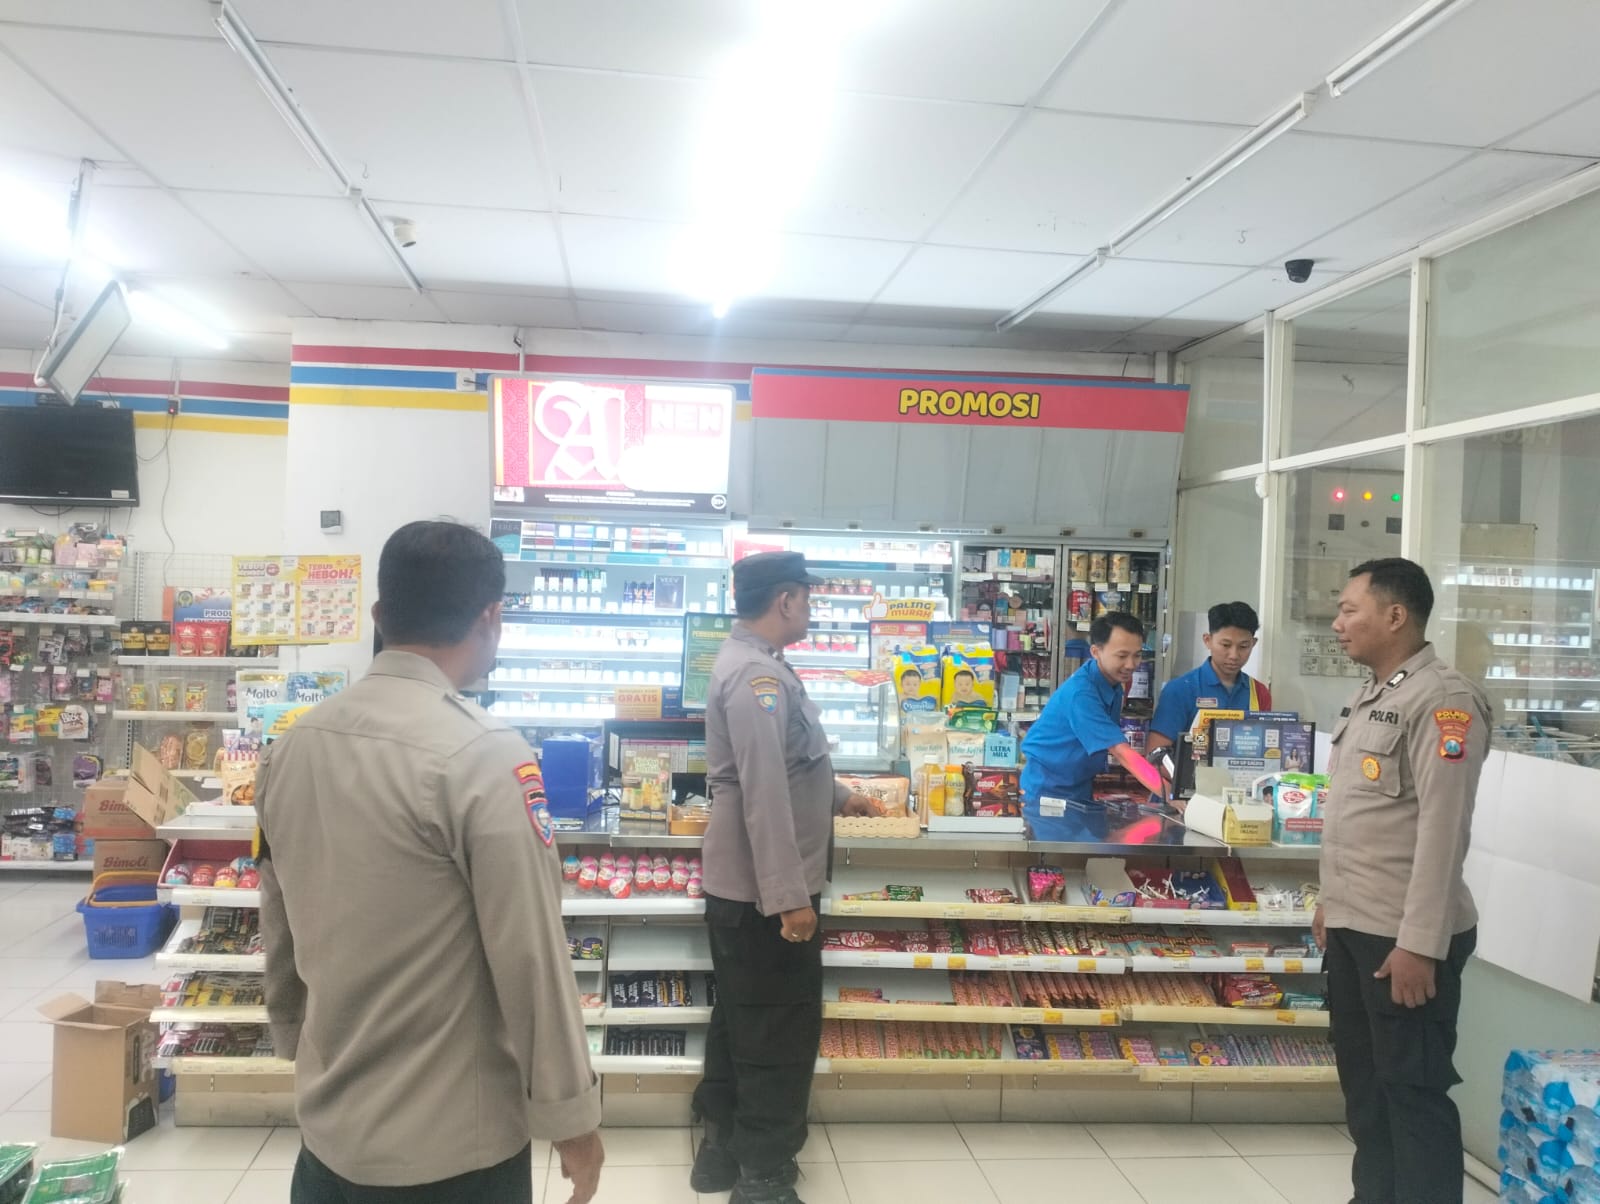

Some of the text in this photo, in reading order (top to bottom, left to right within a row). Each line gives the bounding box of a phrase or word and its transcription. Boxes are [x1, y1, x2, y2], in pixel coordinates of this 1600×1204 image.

[899, 388, 1040, 418] PROMOSI
[308, 569, 354, 579] HEBOH!
[890, 602, 931, 610] PALING
[891, 609, 931, 618] MURAH
[245, 687, 278, 699] Molto
[618, 693, 657, 704] GRATIS
[1369, 710, 1398, 725] POLRI
[103, 855, 149, 868] Bimoli
[841, 931, 875, 947] KitKat
